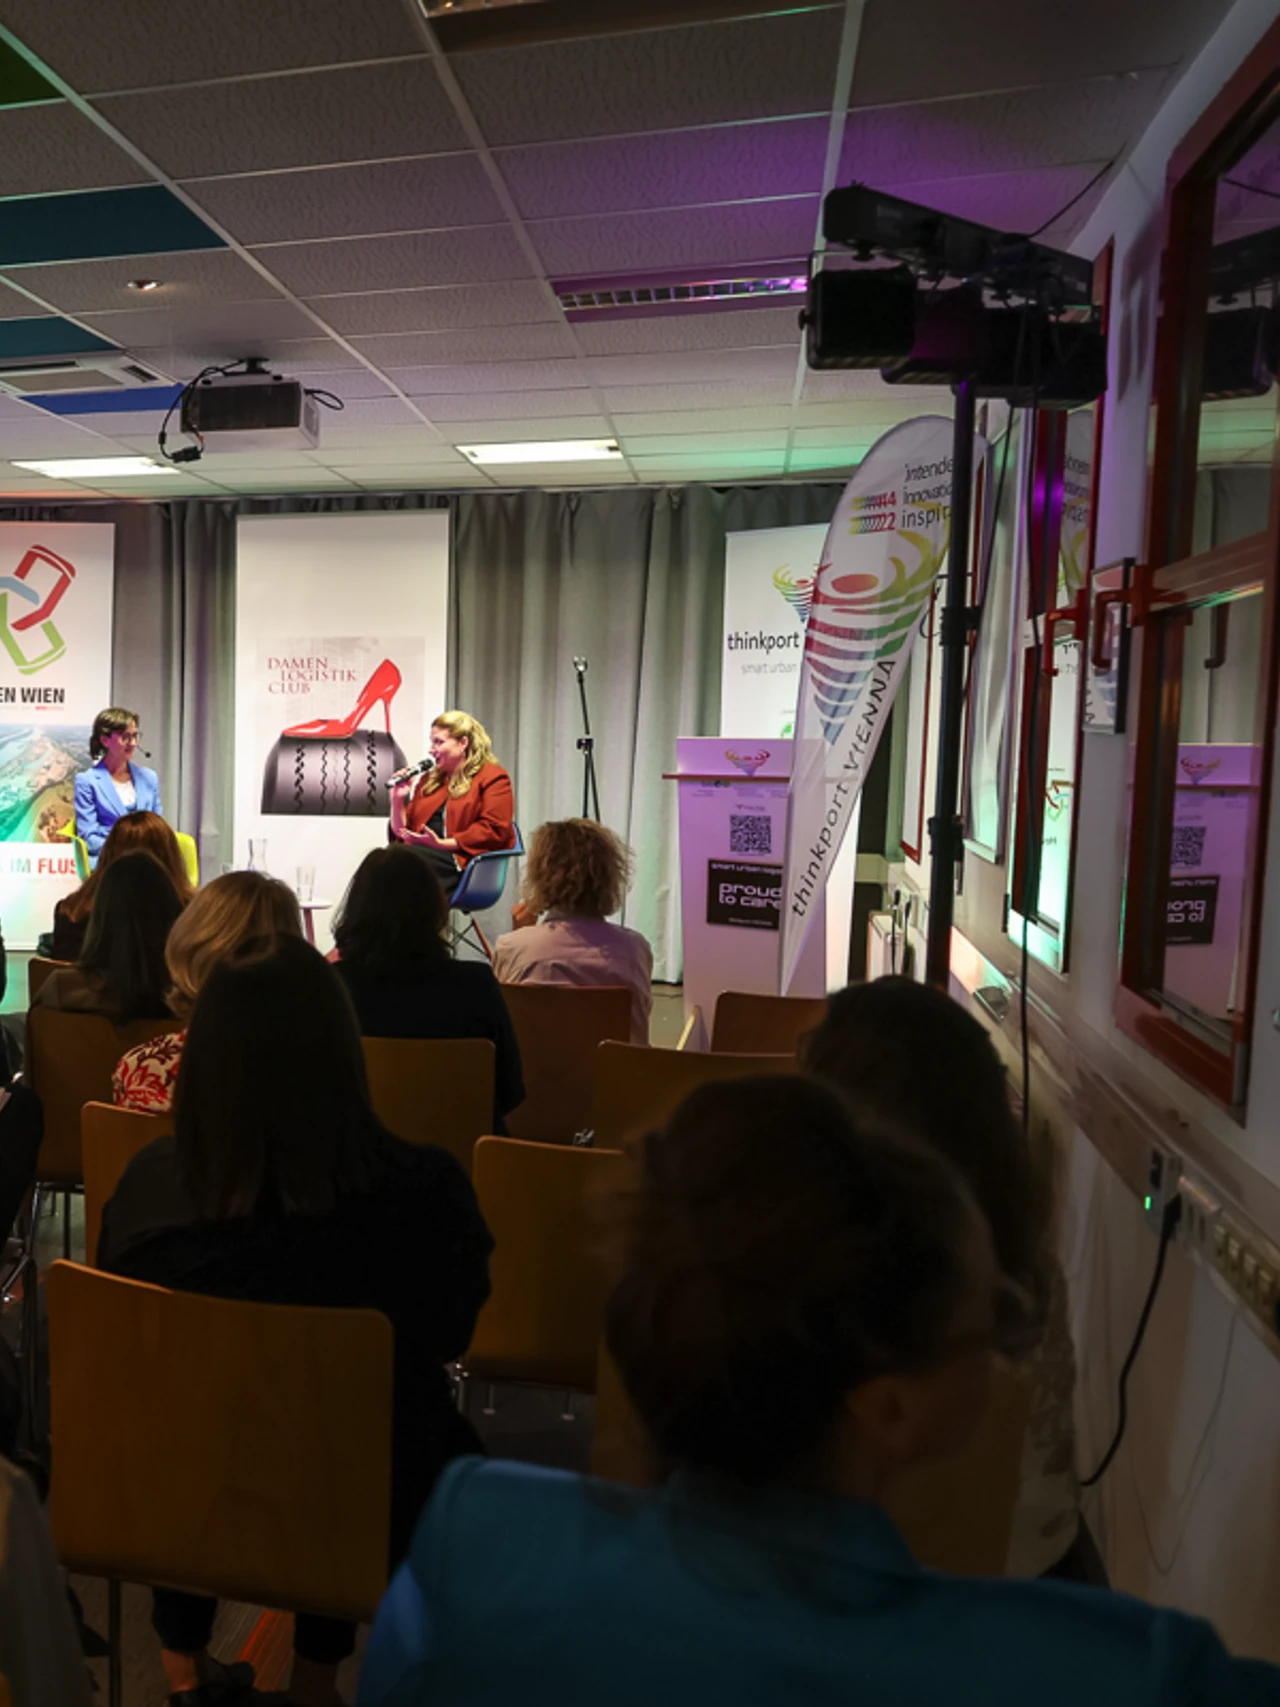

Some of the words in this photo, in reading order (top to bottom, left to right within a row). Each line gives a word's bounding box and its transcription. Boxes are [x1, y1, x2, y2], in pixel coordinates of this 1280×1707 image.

[904, 456, 954, 482] intende
[902, 480, 952, 505] innovatio
[901, 502, 953, 529] inspir
[727, 630, 800, 655] thinkport
[268, 657, 328, 670] DAMEN
[280, 669, 357, 682] LOGISTIK
[20, 687, 66, 704] WIEN
[268, 682, 311, 695] CLUB
[792, 783, 850, 917] thinkport
[844, 659, 898, 775] VIENNA
[10, 856, 32, 873] IM
[37, 857, 76, 875] FLUS
